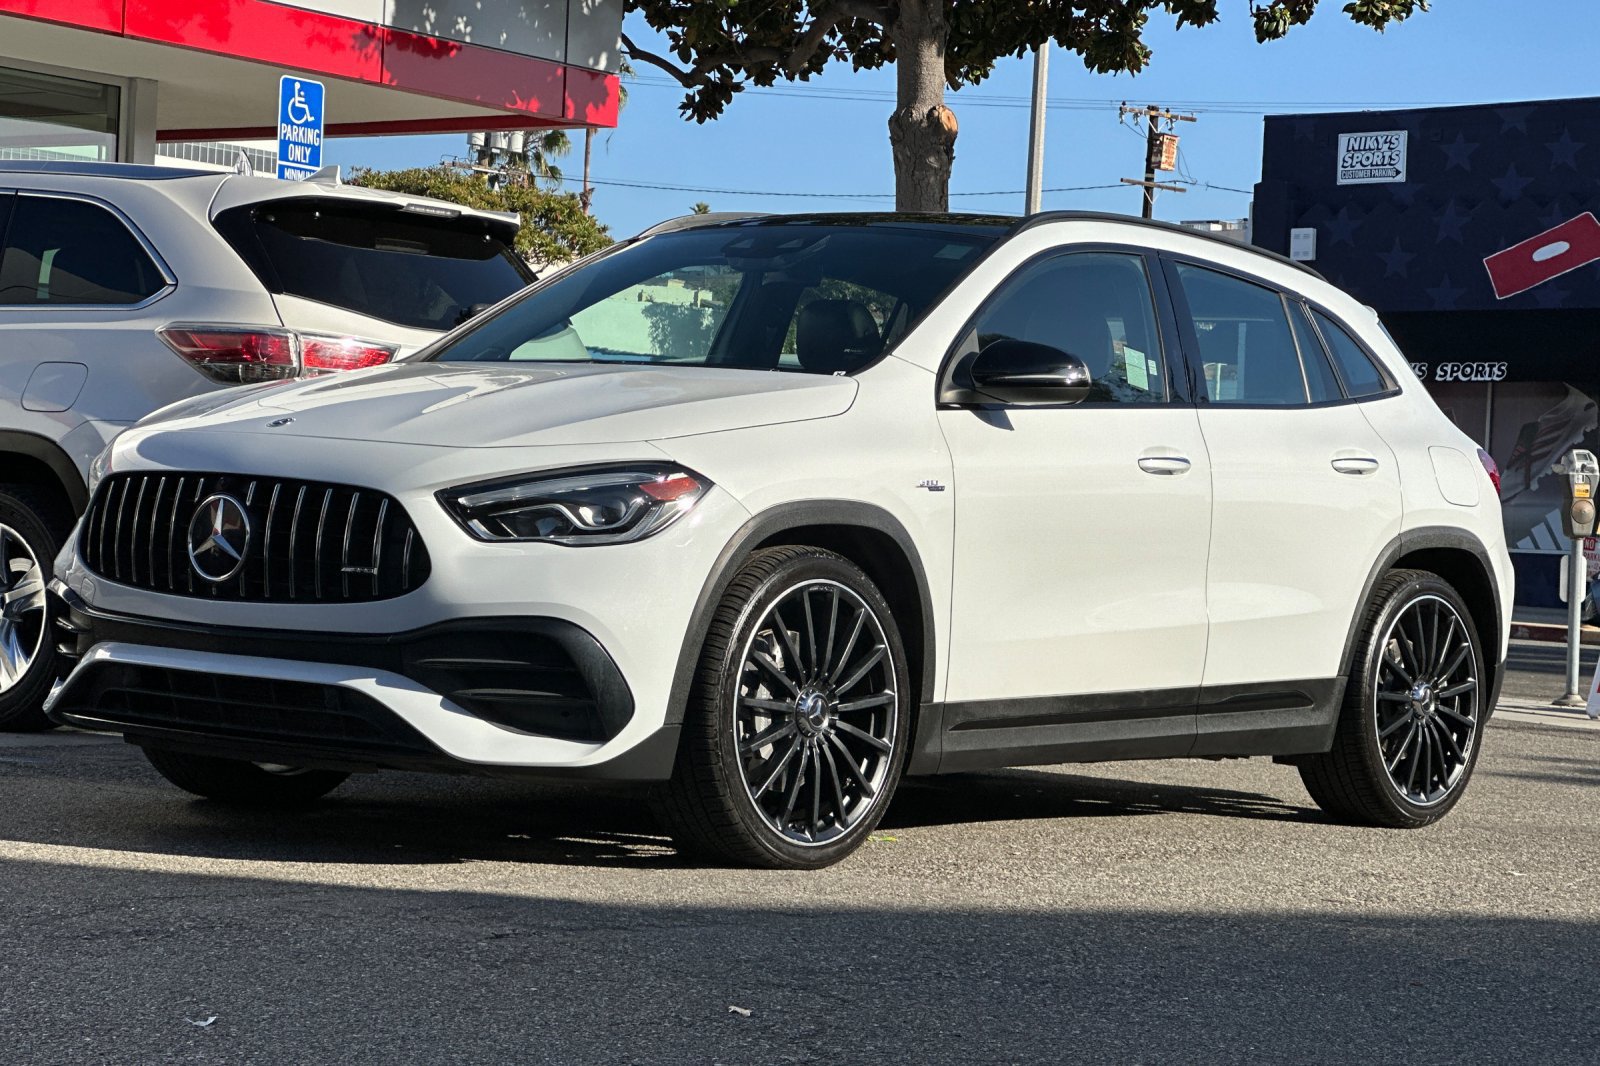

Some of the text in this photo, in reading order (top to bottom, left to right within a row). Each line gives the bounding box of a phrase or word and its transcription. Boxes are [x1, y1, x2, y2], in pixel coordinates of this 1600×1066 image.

[281, 122, 320, 147] PARKING
[1346, 135, 1400, 152] NIKY'S
[288, 143, 311, 163] ONLY
[1341, 150, 1401, 168] SPORTS
[1341, 168, 1396, 179] CUSTOMER PARKING
[1435, 362, 1508, 381] SPORTS
[1584, 538, 1596, 550] NO
